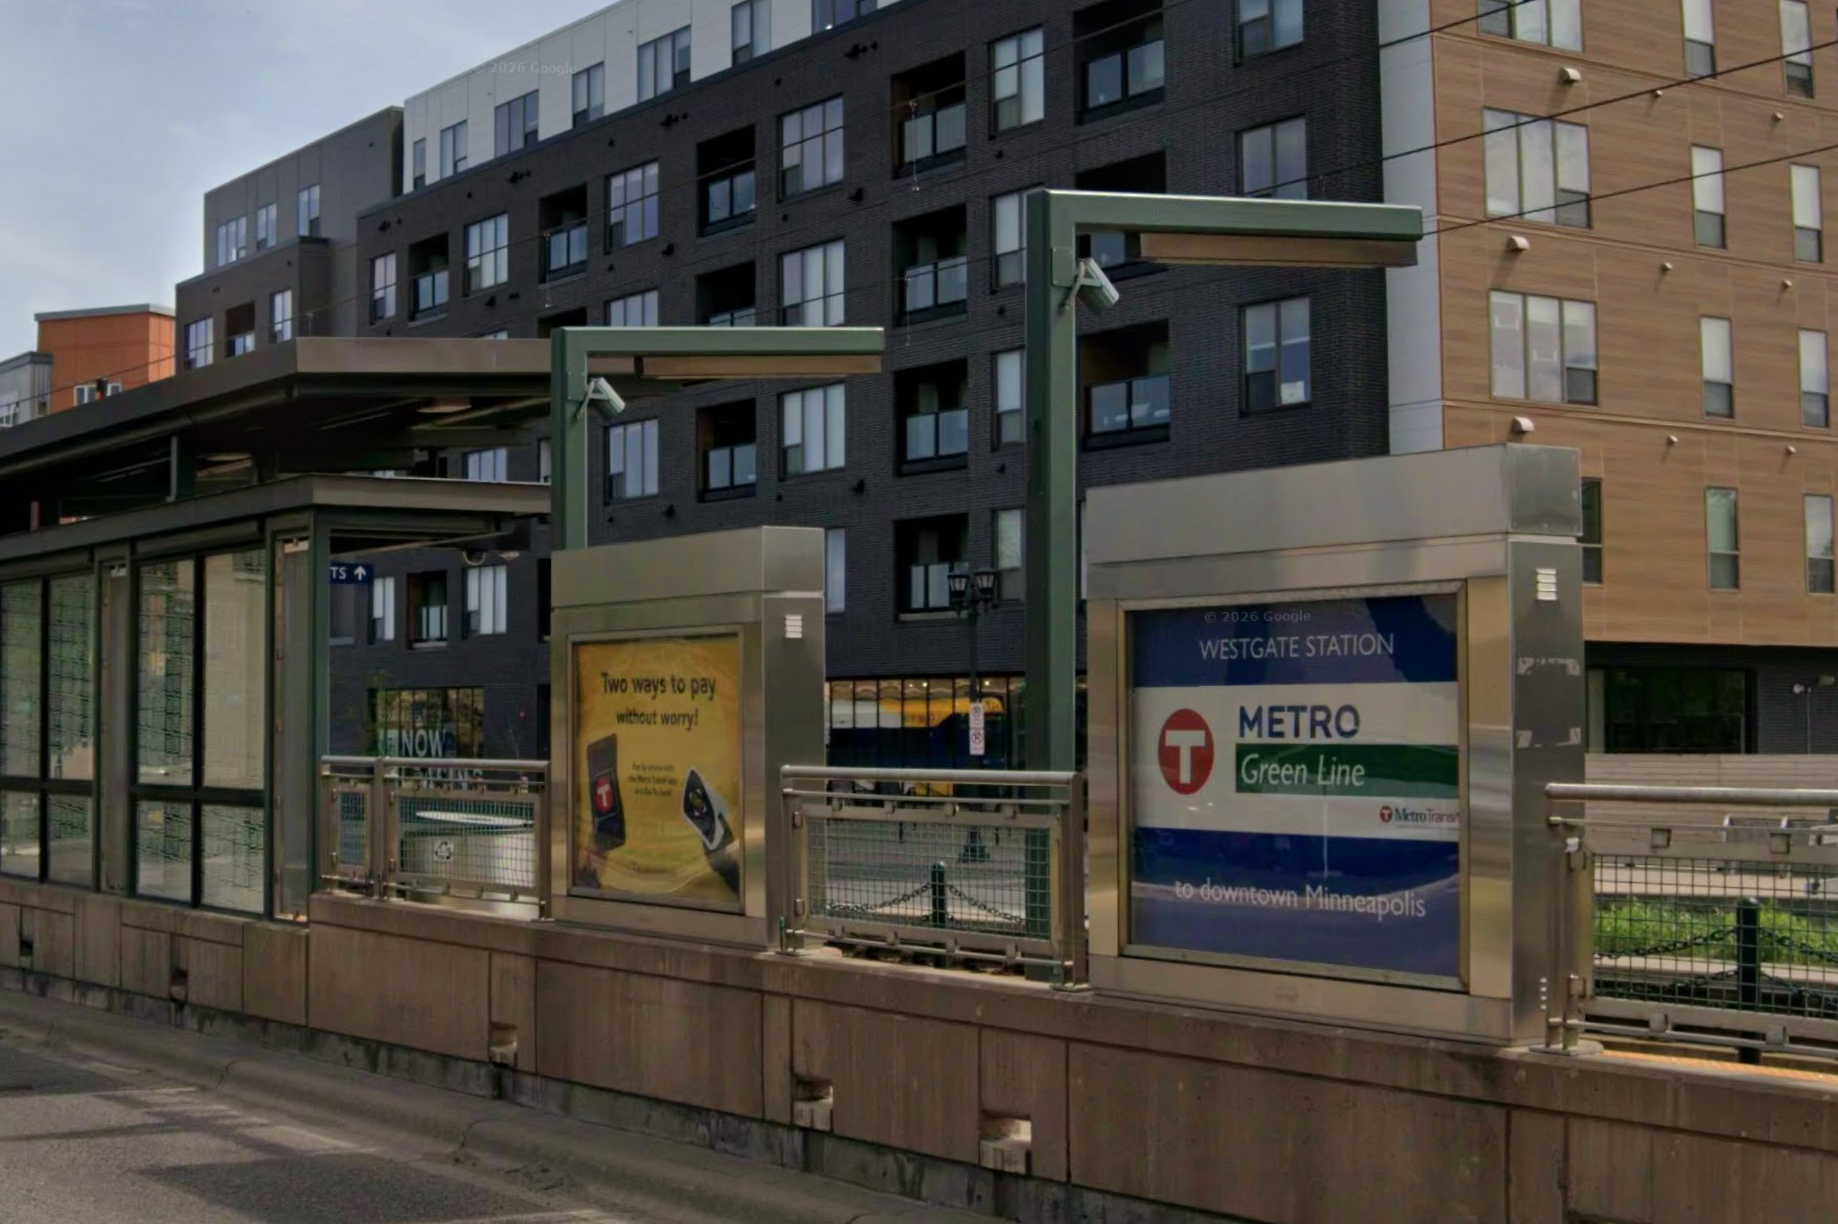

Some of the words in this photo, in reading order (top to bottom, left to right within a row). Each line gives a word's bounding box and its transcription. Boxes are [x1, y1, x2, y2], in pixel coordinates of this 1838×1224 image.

[1199, 636, 1300, 660] WESTGATE
[1305, 633, 1395, 657] STATION
[601, 671, 628, 694] Two
[631, 677, 667, 701] ways
[671, 674, 686, 694] to
[690, 677, 716, 702] pay
[616, 706, 657, 725] without
[660, 708, 699, 731] worry!
[1238, 704, 1361, 739] METRO
[401, 729, 445, 758] NOW
[1165, 730, 1206, 784] T
[1241, 753, 1308, 785] Green
[1317, 754, 1366, 787] Line
[1175, 880, 1194, 899] to
[1200, 877, 1299, 908] downtown
[1305, 884, 1427, 922] Minneapolis
